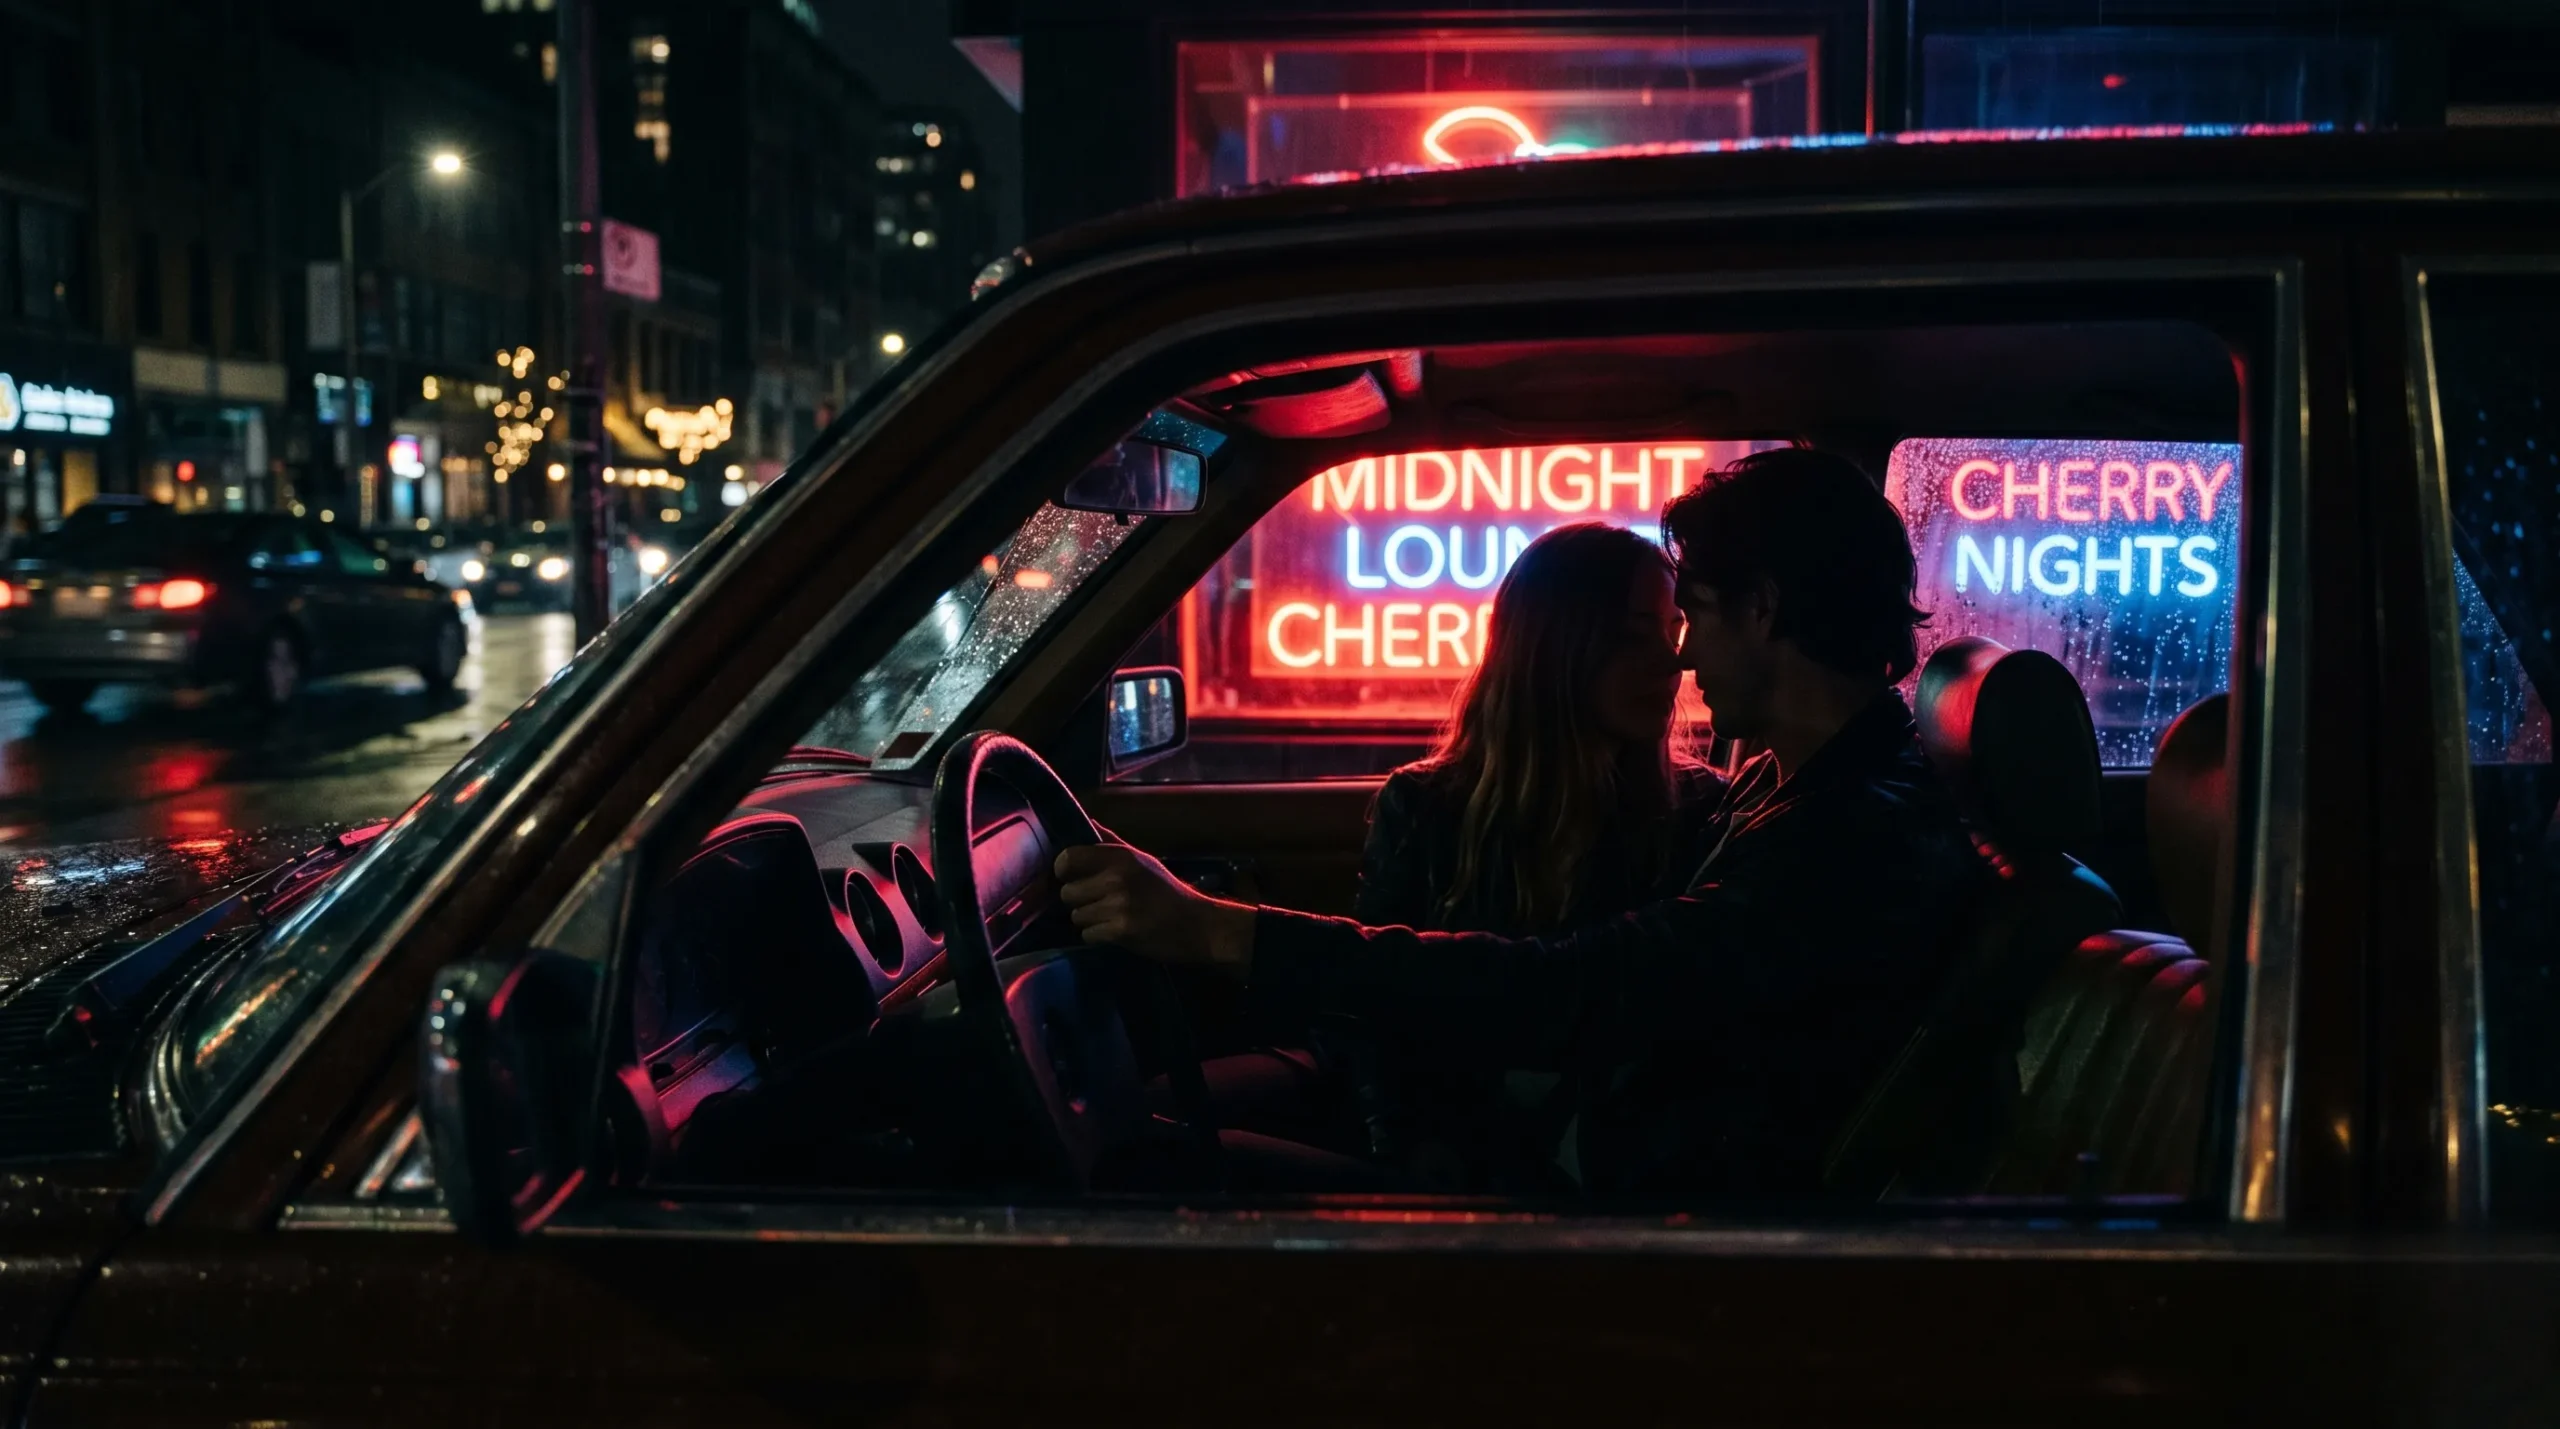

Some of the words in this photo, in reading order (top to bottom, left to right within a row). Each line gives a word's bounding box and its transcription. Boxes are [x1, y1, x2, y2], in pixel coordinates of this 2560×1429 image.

[1312, 446, 1704, 512] MIDNIGHT
[1951, 459, 2233, 522] CHERRY
[1346, 524, 1664, 588] LOU
[1955, 535, 2219, 597] NIGHTS
